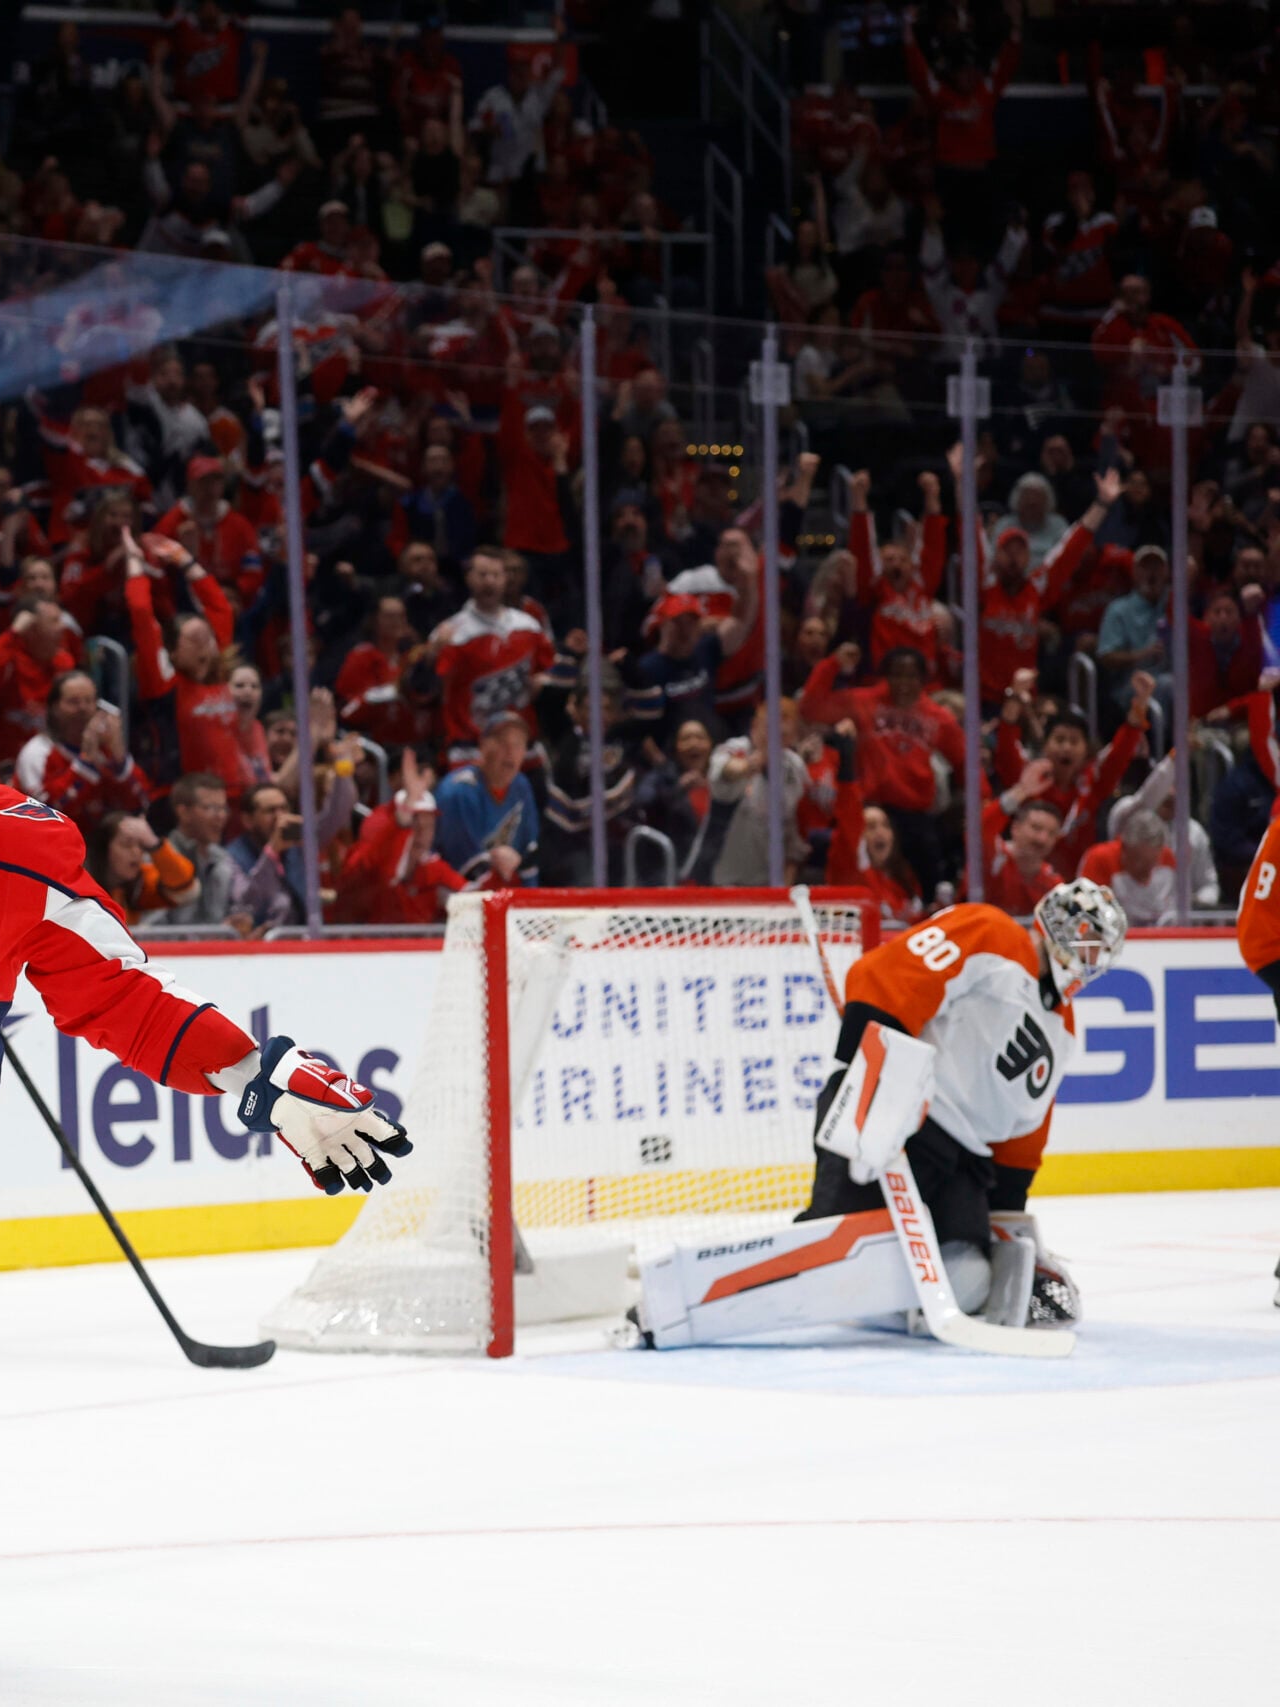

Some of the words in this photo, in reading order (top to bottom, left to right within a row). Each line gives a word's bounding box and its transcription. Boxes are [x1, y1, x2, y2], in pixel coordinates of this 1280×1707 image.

[906, 925, 961, 972] 80
[244, 1090, 255, 1117] CCM
[515, 1055, 823, 1128] IRLINES
[697, 1236, 774, 1260] BAUER
[886, 1171, 939, 1285] BAUER
